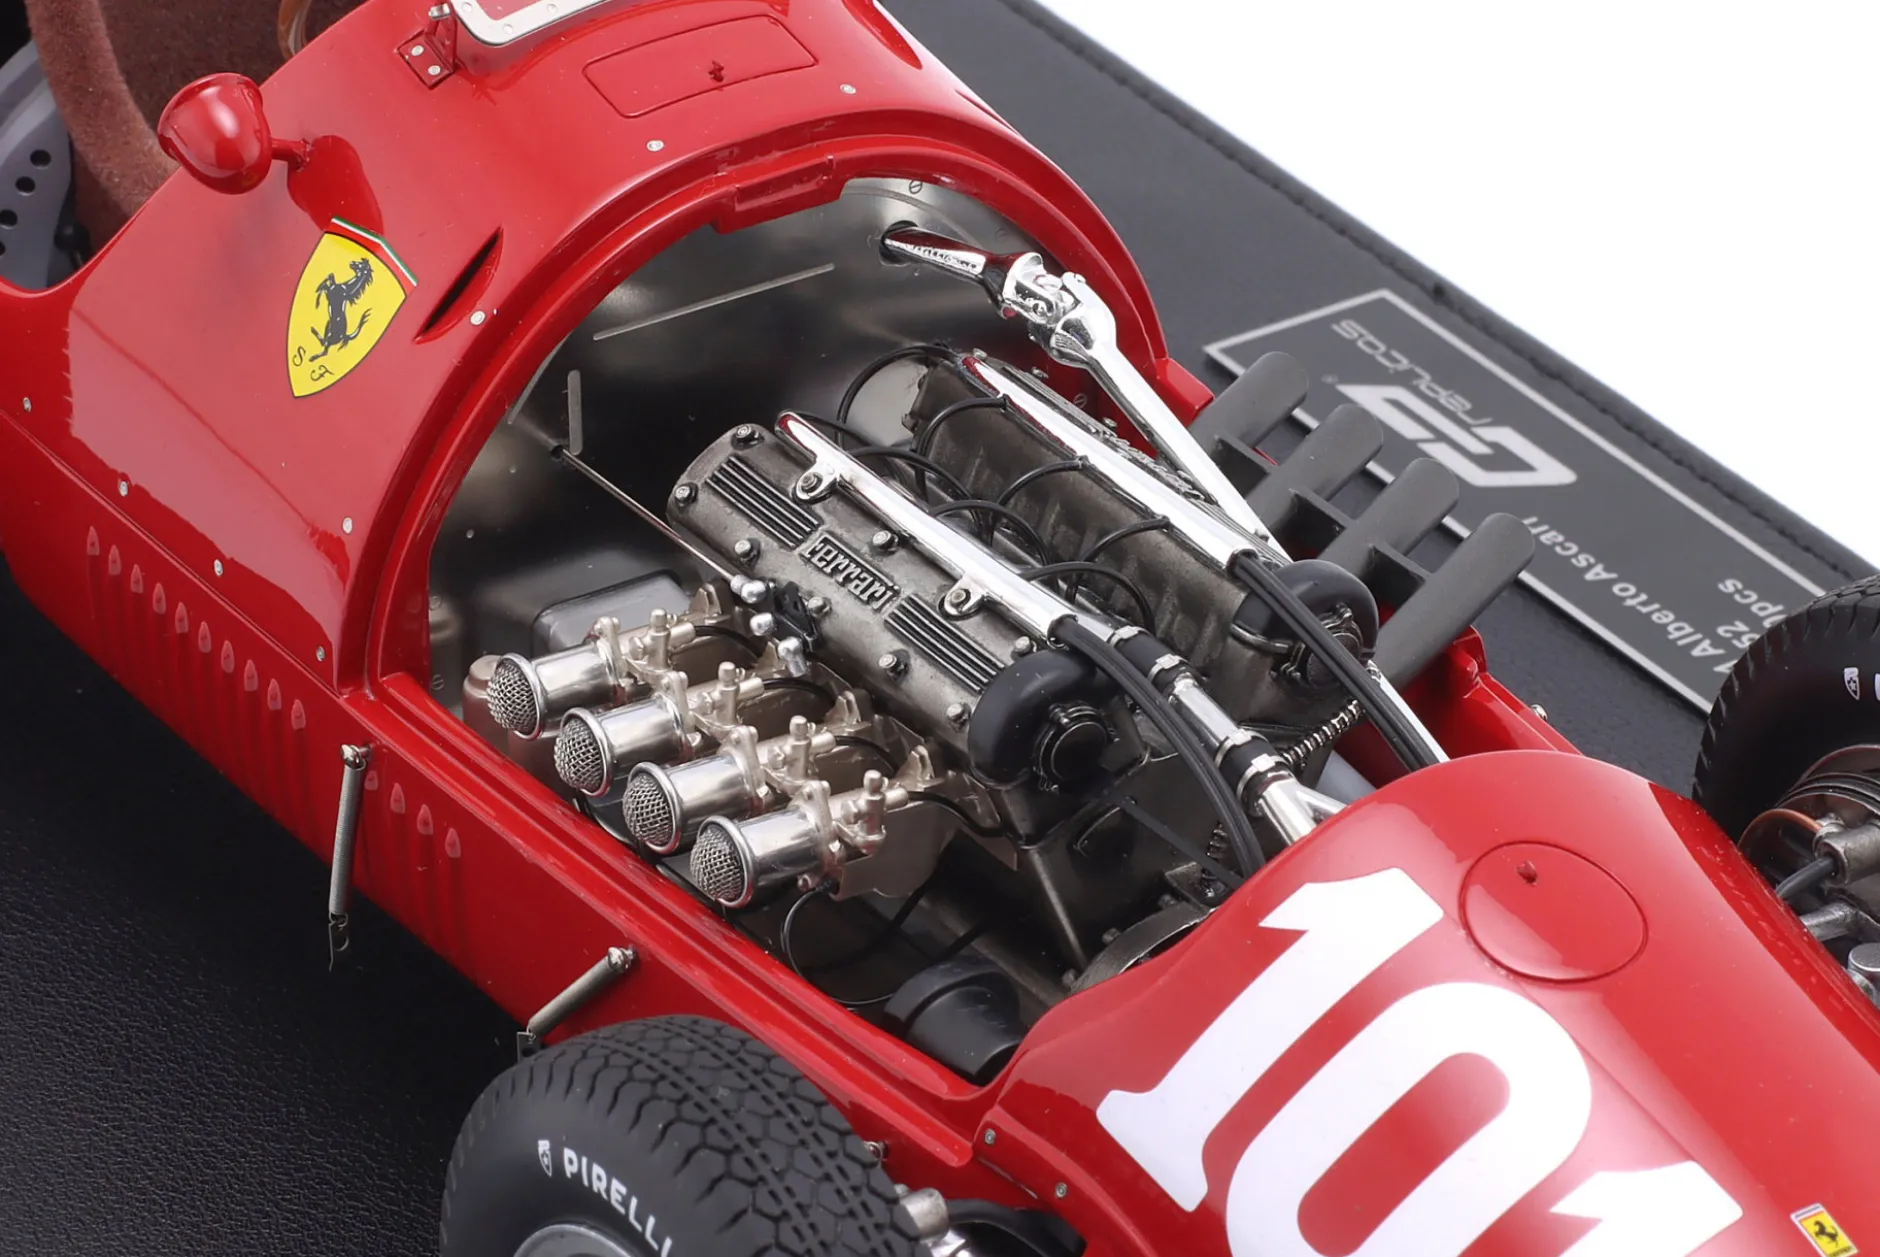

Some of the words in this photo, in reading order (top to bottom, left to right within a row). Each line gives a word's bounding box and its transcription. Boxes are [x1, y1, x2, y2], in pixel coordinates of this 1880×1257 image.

[800, 533, 900, 610] Ferrari
[1611, 581, 1727, 658] Alberto
[563, 1146, 673, 1257] PIRELLI
